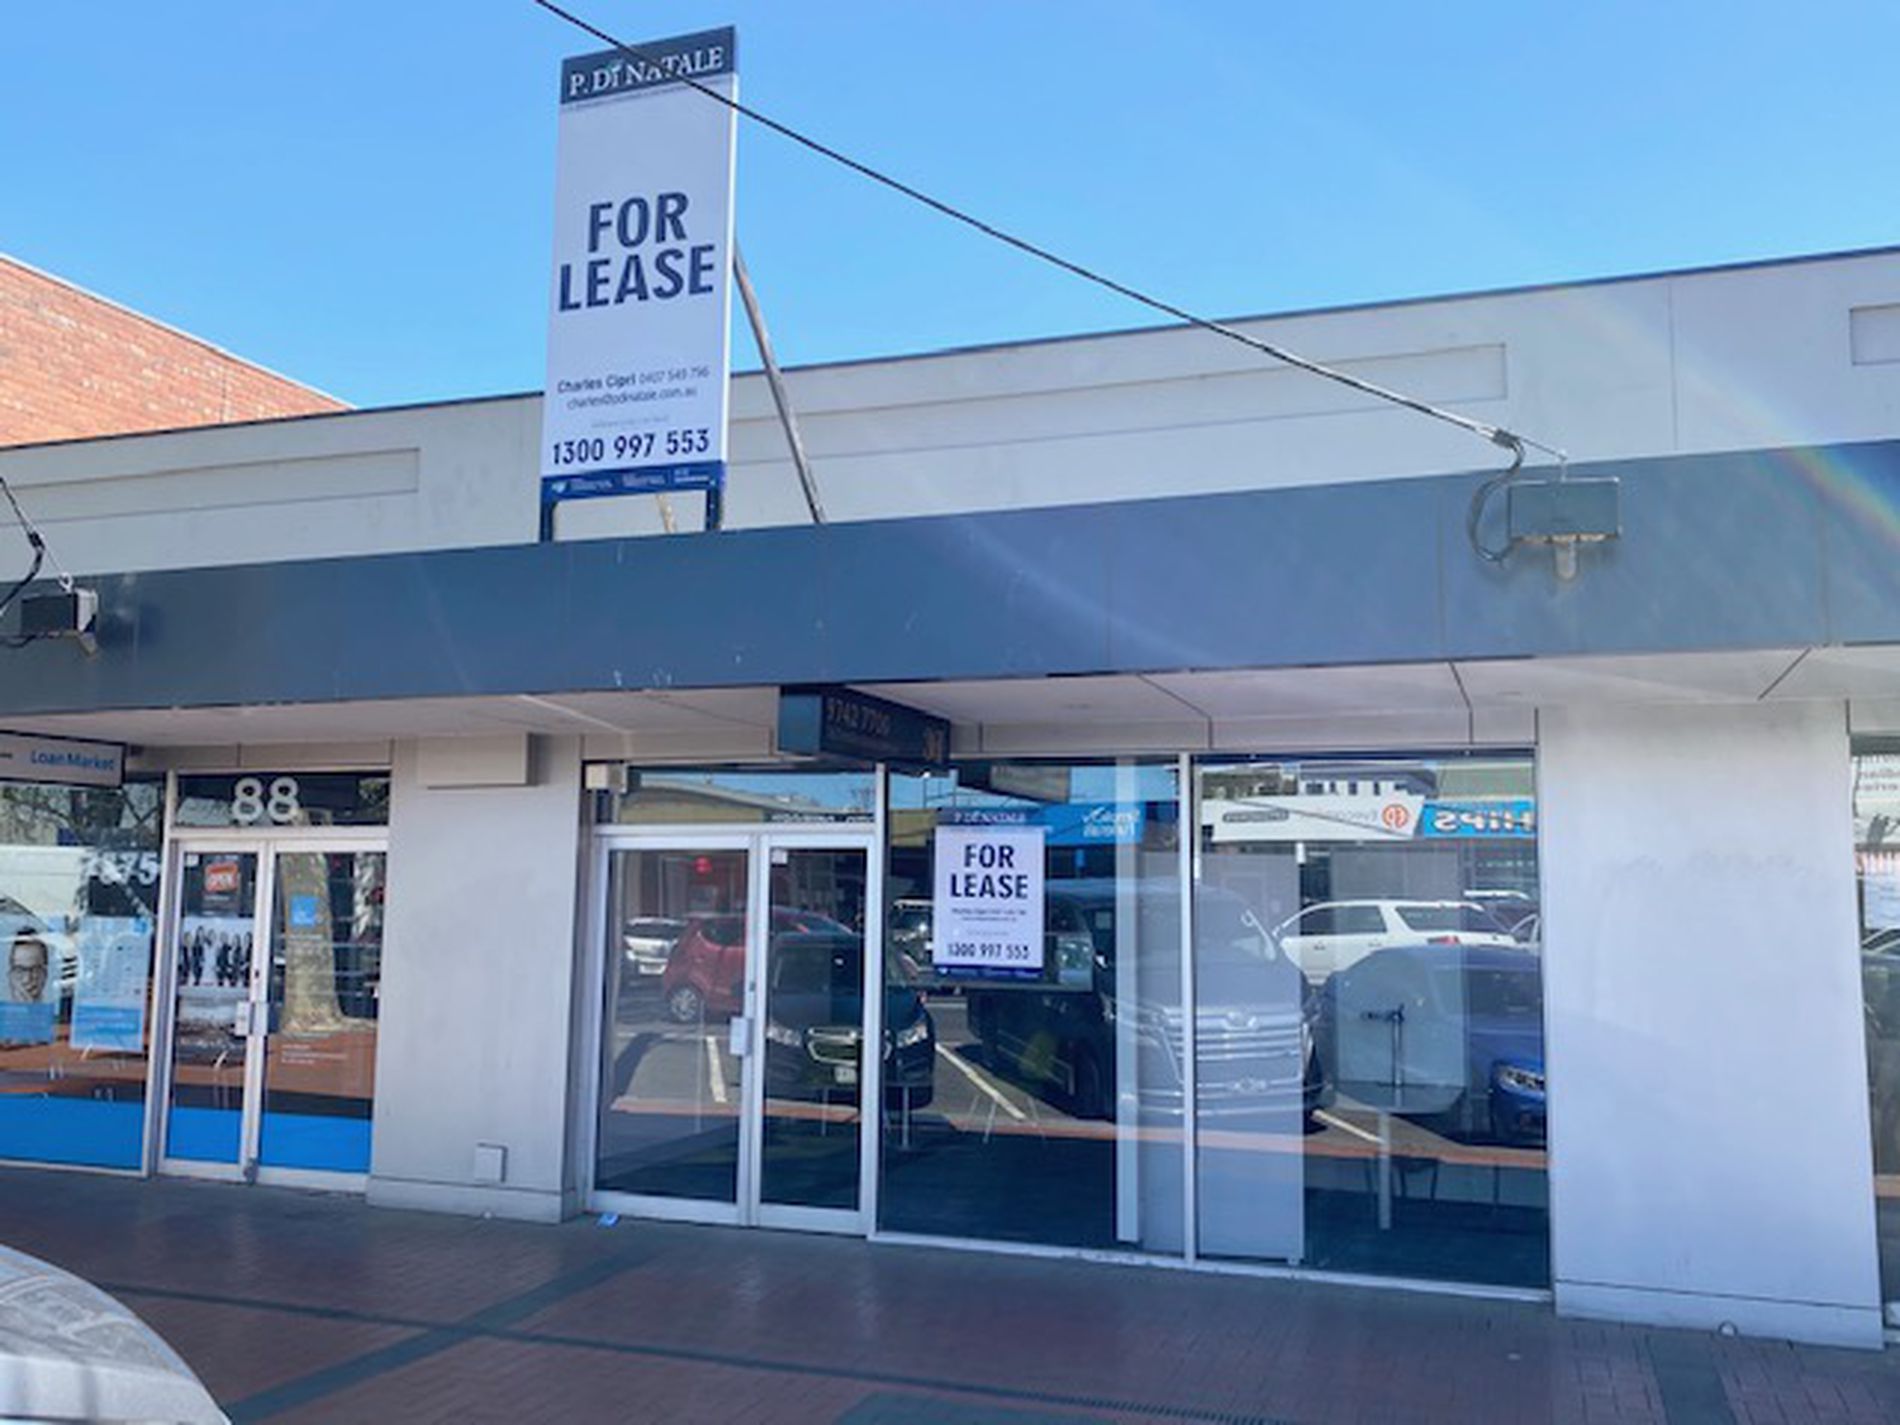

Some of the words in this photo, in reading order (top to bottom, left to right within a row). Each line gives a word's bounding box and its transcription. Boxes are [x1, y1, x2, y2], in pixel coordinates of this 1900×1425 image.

[626, 47, 724, 84] NATALE
[588, 192, 689, 253] FOR
[559, 244, 715, 312] LEASE
[557, 377, 602, 394] Charles
[553, 438, 604, 465] 1300
[614, 433, 655, 460] 997
[666, 428, 710, 455] 553
[231, 777, 300, 823] 88
[964, 844, 1014, 869] FOR
[950, 873, 1028, 899] LEASE
[948, 942, 976, 957] 1300
[980, 943, 1002, 958] 997
[1006, 944, 1030, 960] 553
